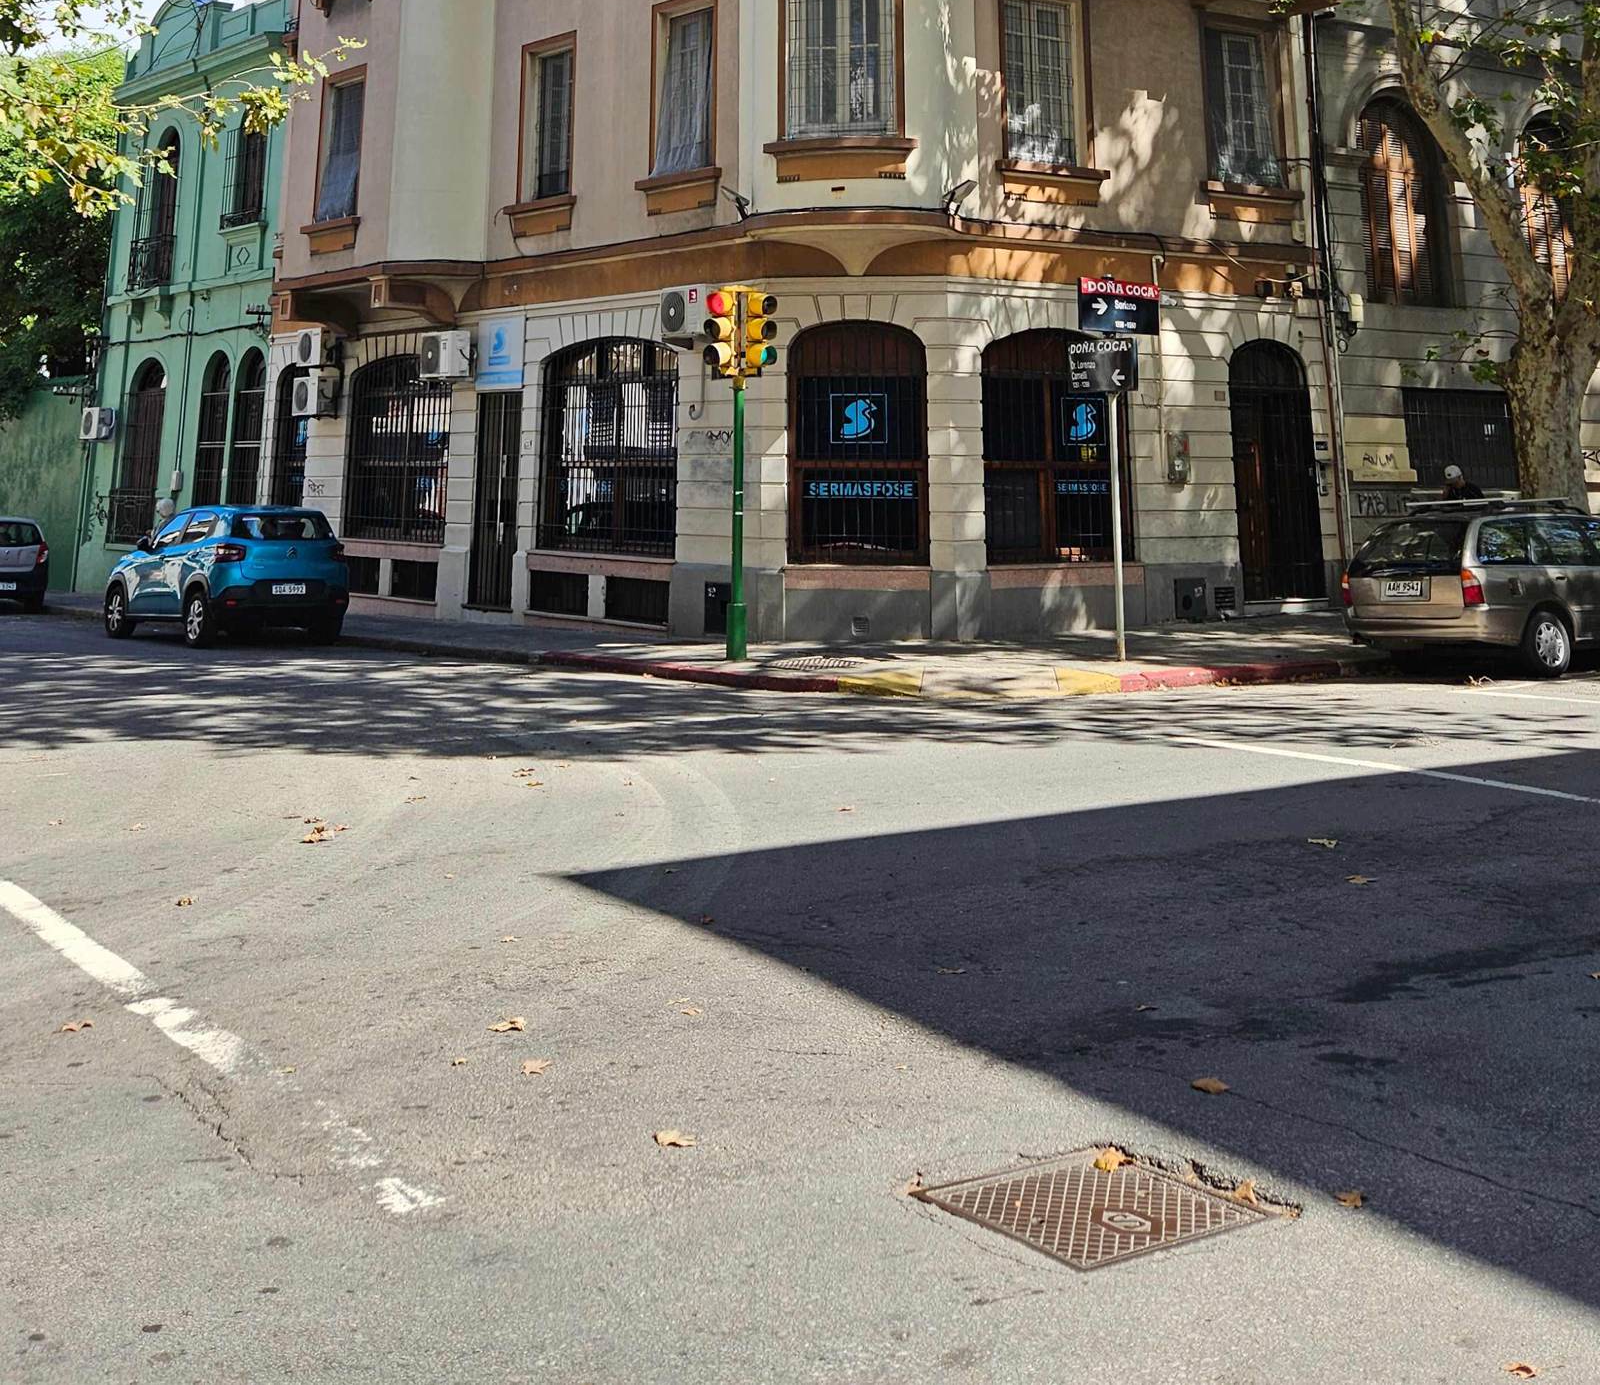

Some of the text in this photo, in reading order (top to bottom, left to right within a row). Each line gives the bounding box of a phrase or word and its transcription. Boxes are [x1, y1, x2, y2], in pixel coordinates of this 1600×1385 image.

[1087, 280, 1155, 298] DOÑA COCA
[1070, 340, 1128, 355] DOÑA COCA
[809, 483, 913, 496] SERMASFOSE
